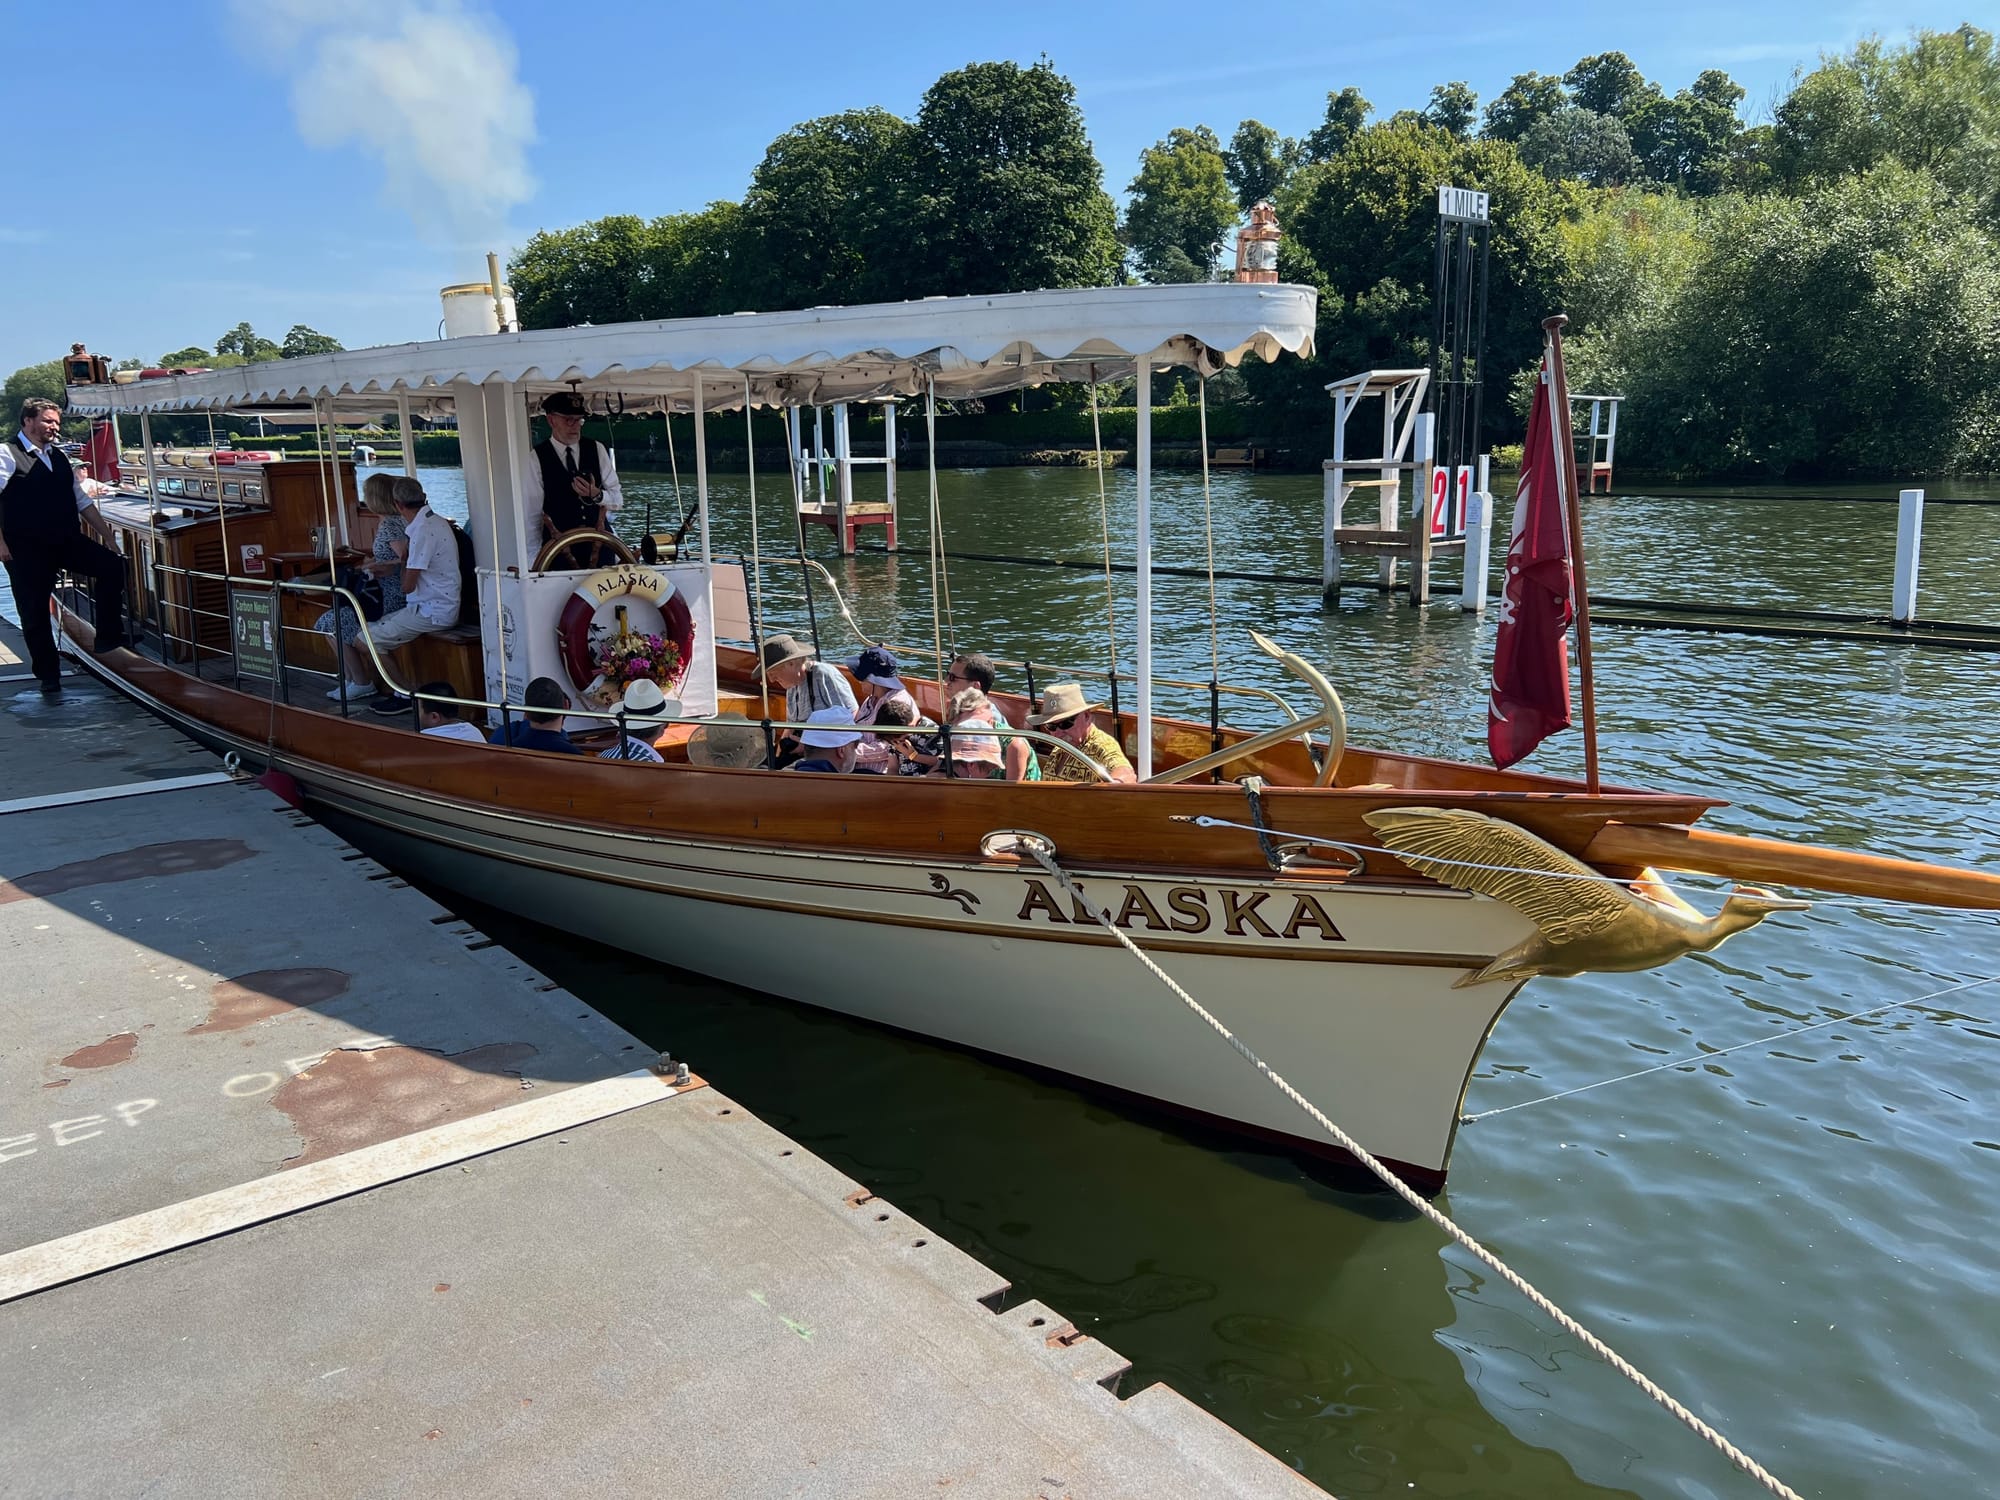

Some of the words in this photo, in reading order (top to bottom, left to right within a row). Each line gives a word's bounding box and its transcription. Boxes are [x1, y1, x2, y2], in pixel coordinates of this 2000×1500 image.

[1445, 190, 1449, 214] 1
[1455, 191, 1484, 219] MILE
[597, 572, 659, 596] ALASKA
[235, 599, 253, 613] Carbon
[247, 618, 261, 630] since
[1017, 879, 1347, 942] ALASKA
